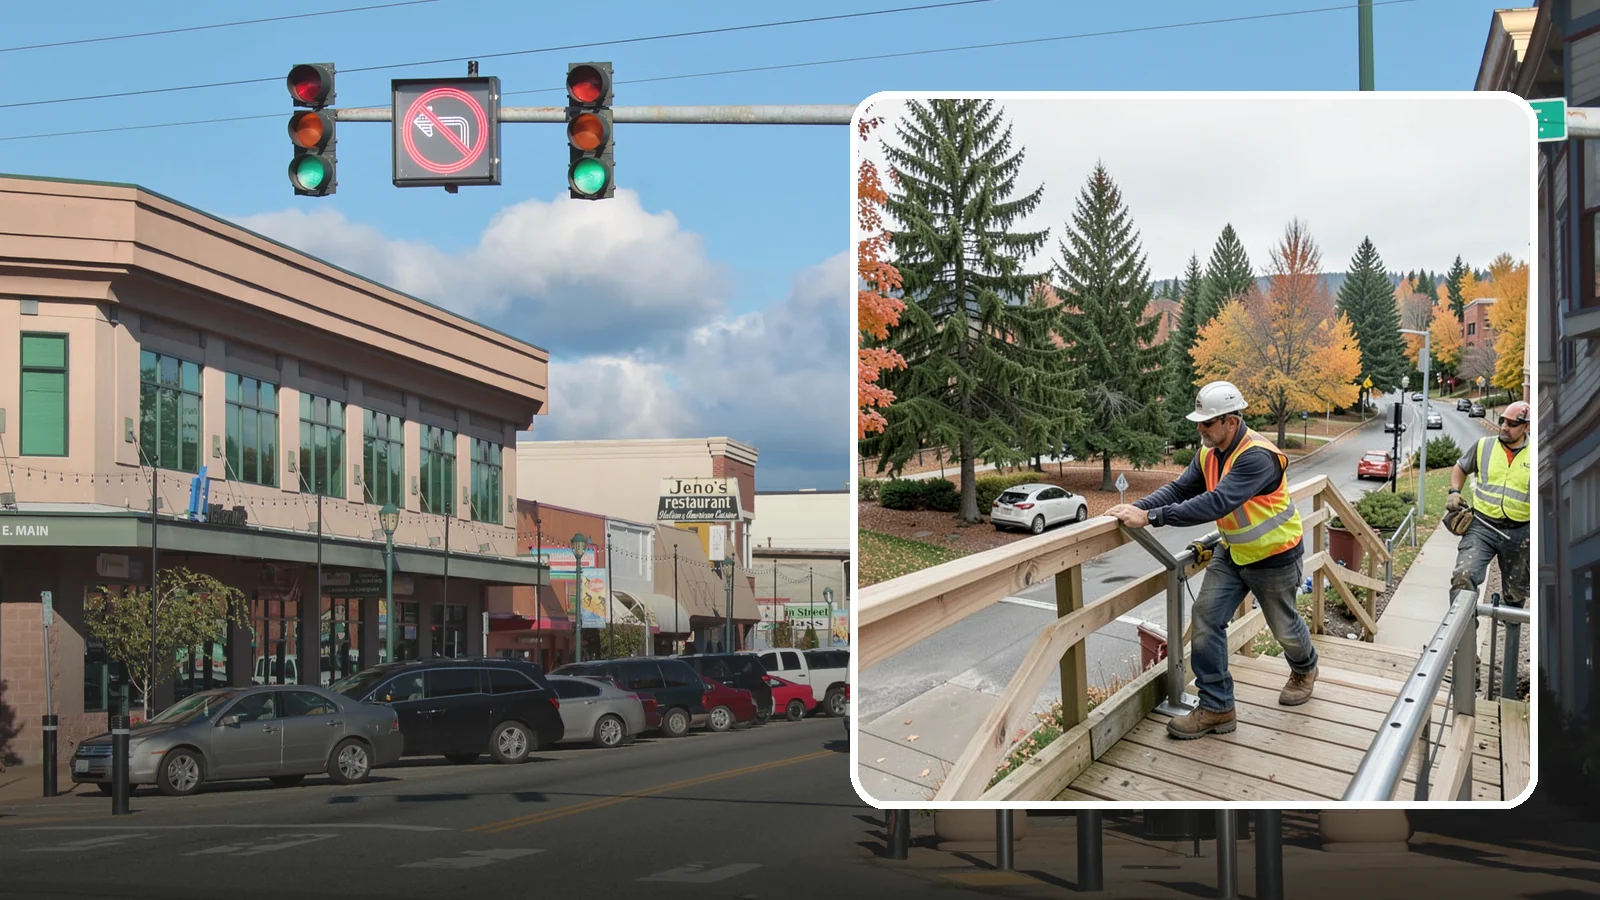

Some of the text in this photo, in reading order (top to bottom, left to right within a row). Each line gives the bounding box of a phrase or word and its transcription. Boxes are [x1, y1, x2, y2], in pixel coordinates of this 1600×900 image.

[670, 480, 727, 494] Jeno's
[665, 497, 730, 509] restaurant
[659, 510, 681, 519] Italian
[686, 510, 714, 519] American
[715, 509, 737, 519] Cuisine
[2, 525, 49, 536] E. MAIN
[798, 608, 828, 616] Street
